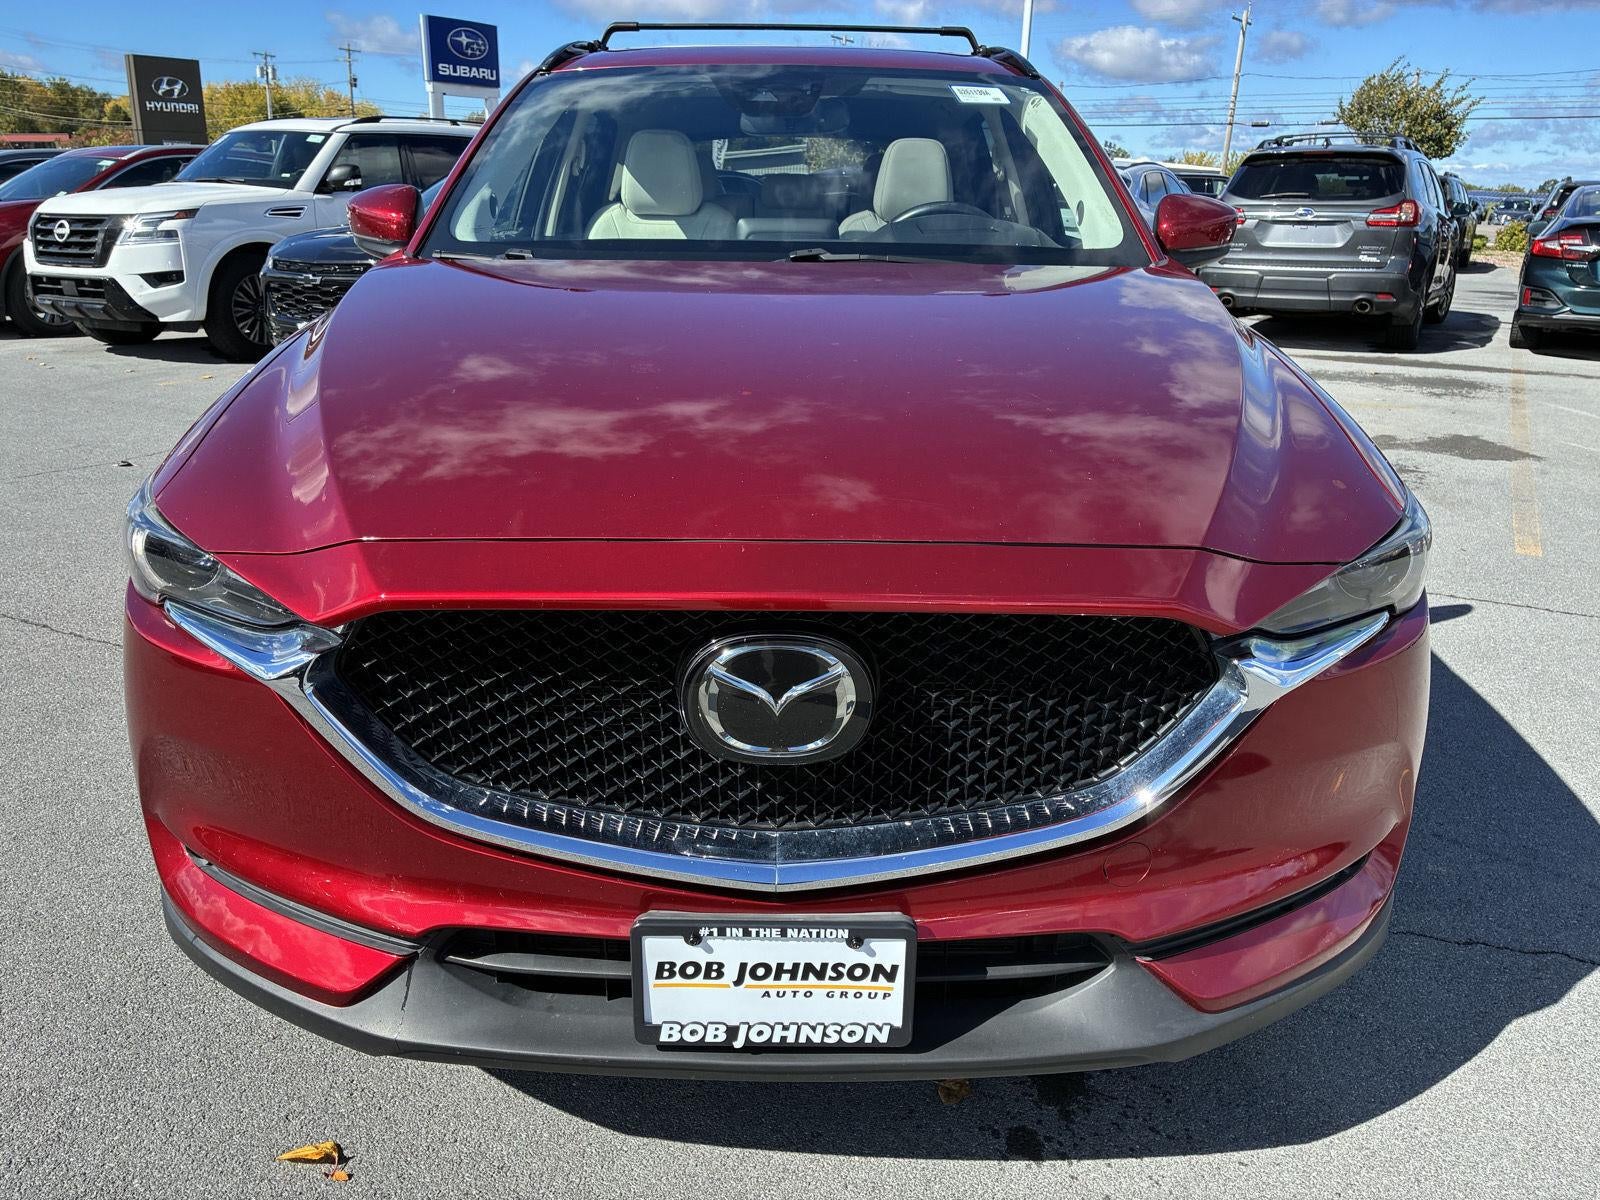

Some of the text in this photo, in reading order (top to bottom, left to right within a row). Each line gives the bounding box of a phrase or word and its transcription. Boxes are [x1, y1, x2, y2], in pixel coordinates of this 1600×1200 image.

[438, 63, 497, 80] SUBARU
[145, 101, 199, 113] HYUNDAI
[699, 926, 849, 938] #1 IN THE NATION
[655, 960, 900, 987] BOB JOHNSON
[761, 990, 892, 1000] AUTO GROUP
[659, 1022, 891, 1049] BOB JOHNSON
